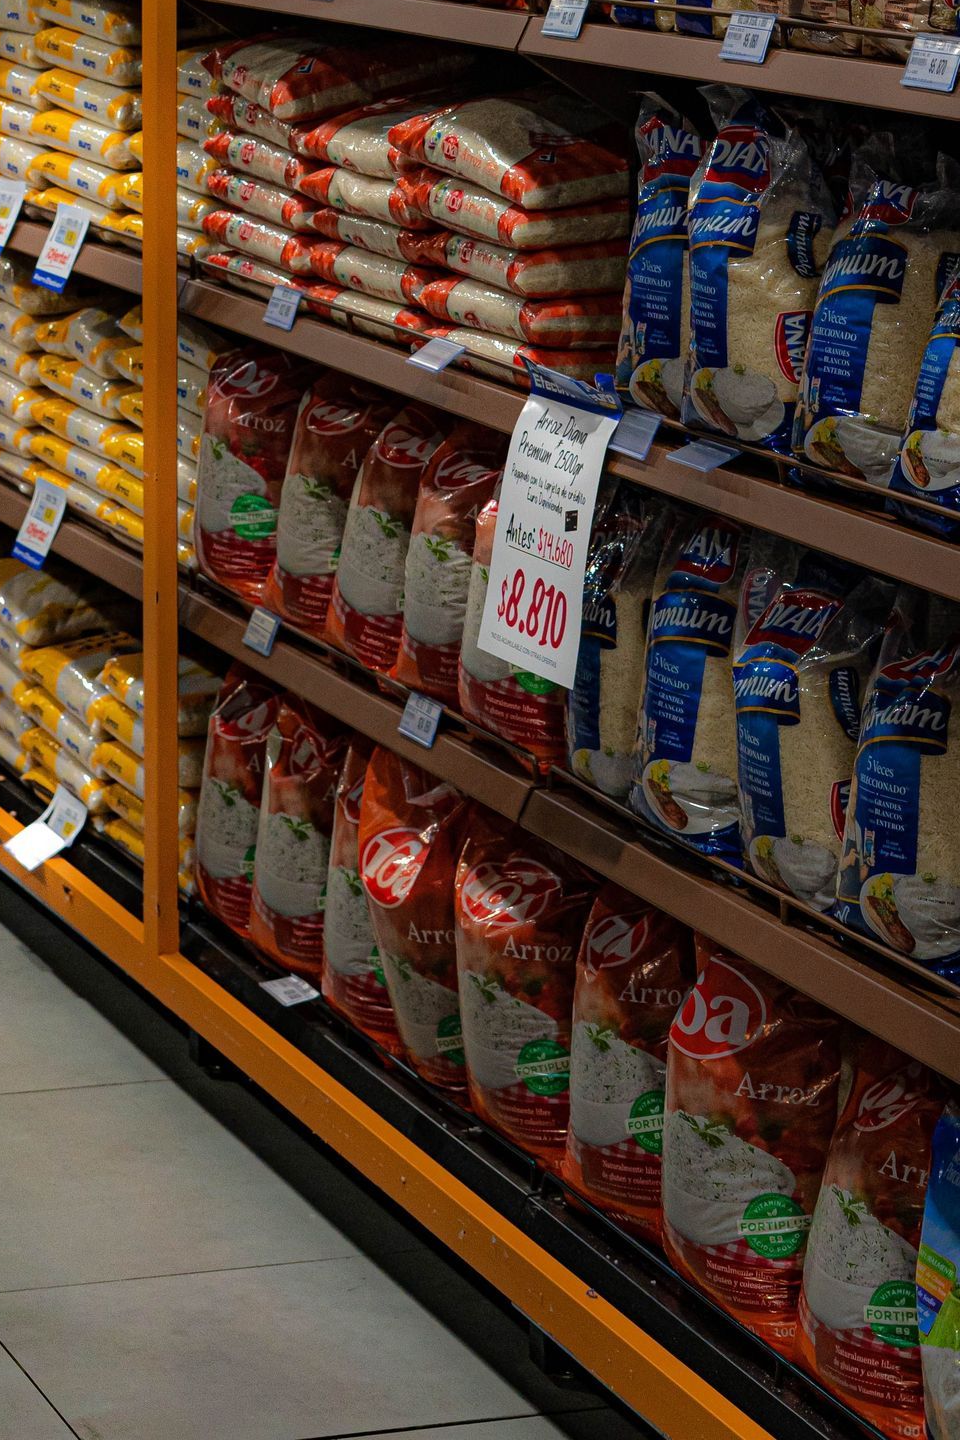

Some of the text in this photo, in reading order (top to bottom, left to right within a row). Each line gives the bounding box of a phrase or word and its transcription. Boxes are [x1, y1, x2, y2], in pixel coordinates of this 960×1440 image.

[827, 310, 848, 326] Veces
[823, 356, 851, 367] BLANCOS
[824, 346, 851, 358] GRANDES
[823, 366, 852, 378] ENTEROS
[534, 408, 589, 449] Arroz Diana
[518, 430, 584, 486] Premium 2500gr
[526, 486, 538, 505] Euro
[506, 513, 574, 568] Antes: $14.680
[498, 568, 567, 649] $8.810
[660, 656, 679, 675] Veces
[866, 755, 895, 779] 5 Veces
[874, 798, 902, 812] GRANDES
[874, 807, 904, 822] BLANCOS
[876, 818, 906, 833] ENTEROS
[408, 920, 456, 946] Arro
[501, 933, 574, 962] Arroz
[618, 980, 684, 1007] Arro
[516, 1059, 570, 1079] FORTIPLU
[733, 1071, 821, 1107] Arroz
[877, 1149, 930, 1189] Arr
[740, 1216, 811, 1233] FORTIPLUS
[880, 1290, 916, 1302] VITAMIN
[866, 1308, 918, 1323] FORTIP
